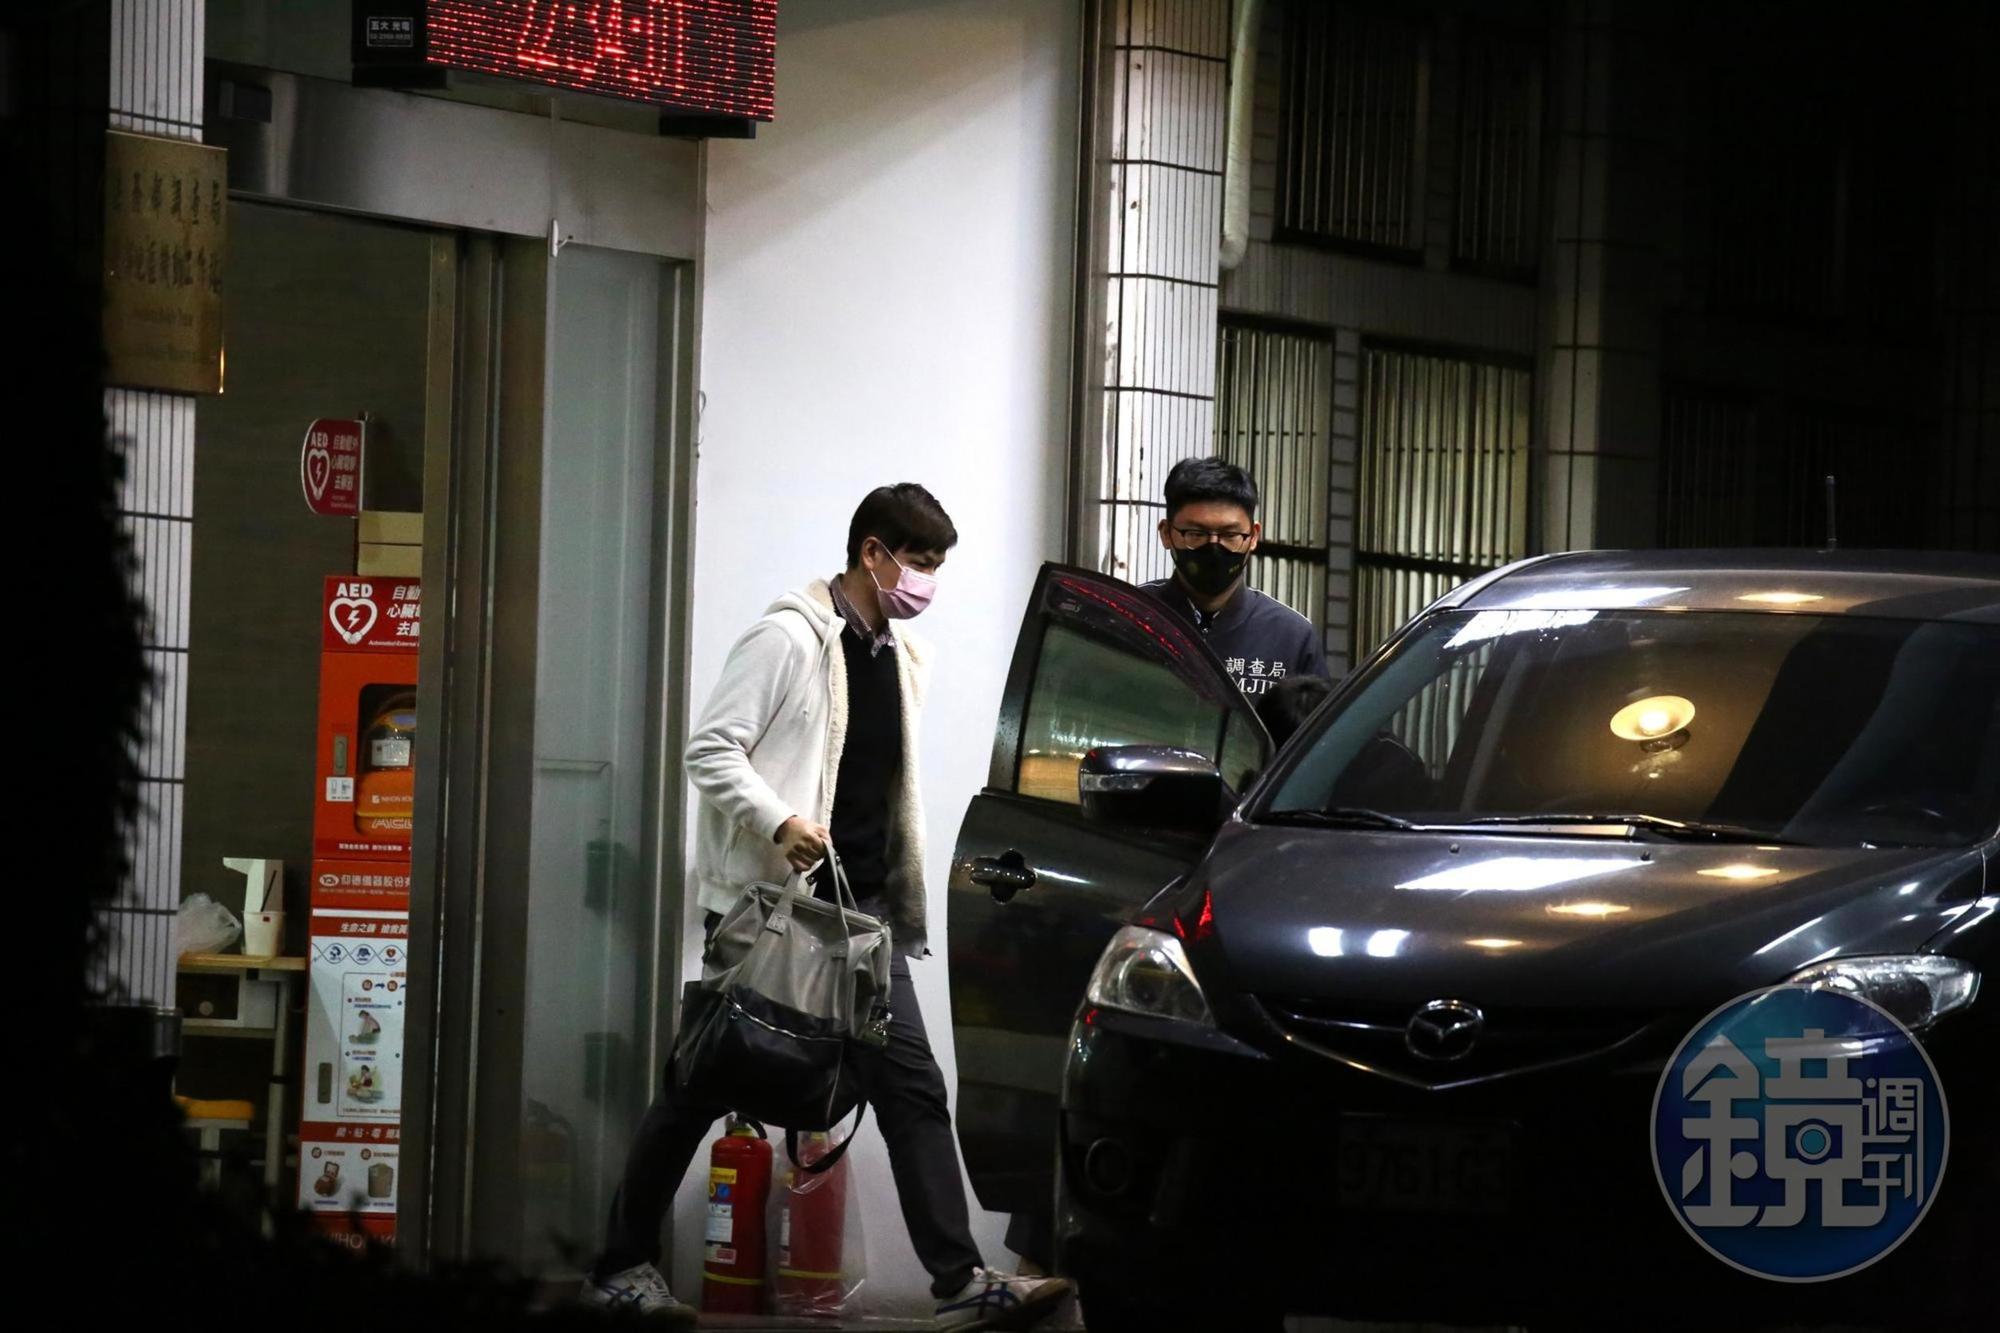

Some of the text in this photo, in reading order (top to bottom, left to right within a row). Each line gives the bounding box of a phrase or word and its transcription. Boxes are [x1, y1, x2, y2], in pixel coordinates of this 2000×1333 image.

[311, 432, 328, 448] AED
[336, 582, 374, 598] AED
[1224, 656, 1287, 680] 調查局
